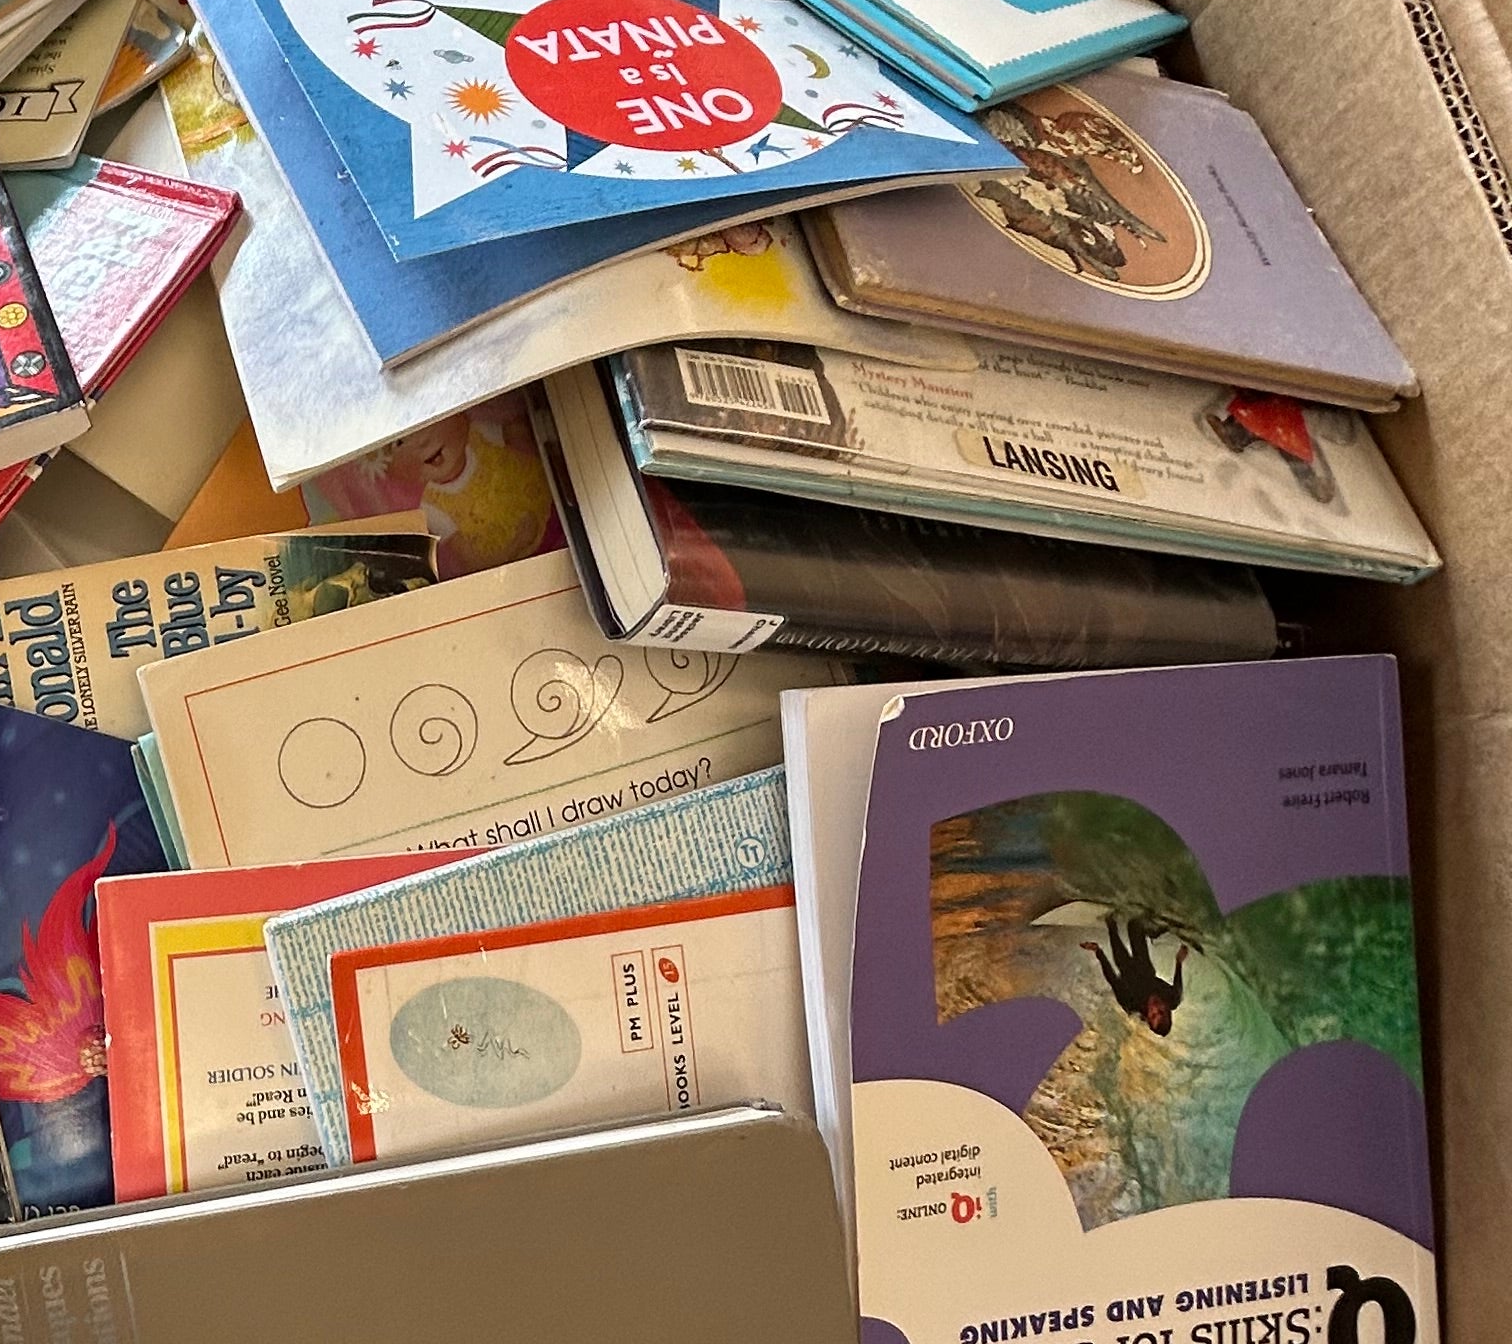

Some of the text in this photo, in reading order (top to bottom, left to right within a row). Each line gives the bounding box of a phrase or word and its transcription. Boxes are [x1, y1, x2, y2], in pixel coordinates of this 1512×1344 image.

[516, 6, 723, 69] PIÑATA
[618, 64, 643, 86] a
[616, 87, 752, 134] ONE
[850, 360, 973, 399] Mystery Mansion
[982, 436, 1119, 491] LANSING
[261, 554, 286, 597] Novel
[99, 578, 158, 659] The
[150, 569, 211, 659] Blue
[61, 582, 95, 714] LONELY SILVER RAIN
[908, 716, 1015, 752] OXFORD
[1278, 760, 1369, 782] Tamara Jones
[484, 811, 542, 849] shall
[560, 786, 625, 827] draw
[628, 756, 713, 806] today?
[1324, 788, 1372, 806] Robert
[622, 963, 642, 1040] PM PLUS
[666, 992, 683, 1044] LEVEL
[207, 1064, 274, 1083] SOLDIER
[236, 1111, 254, 1125] be
[258, 1108, 285, 1123] and
[266, 1150, 281, 1161] to
[889, 1143, 980, 1170] digital content
[916, 1166, 980, 1188] integrated
[896, 1191, 982, 1223] iQ ONLINE:
[1102, 1293, 1166, 1325] AND
[1175, 1272, 1307, 1311] LISTENING
